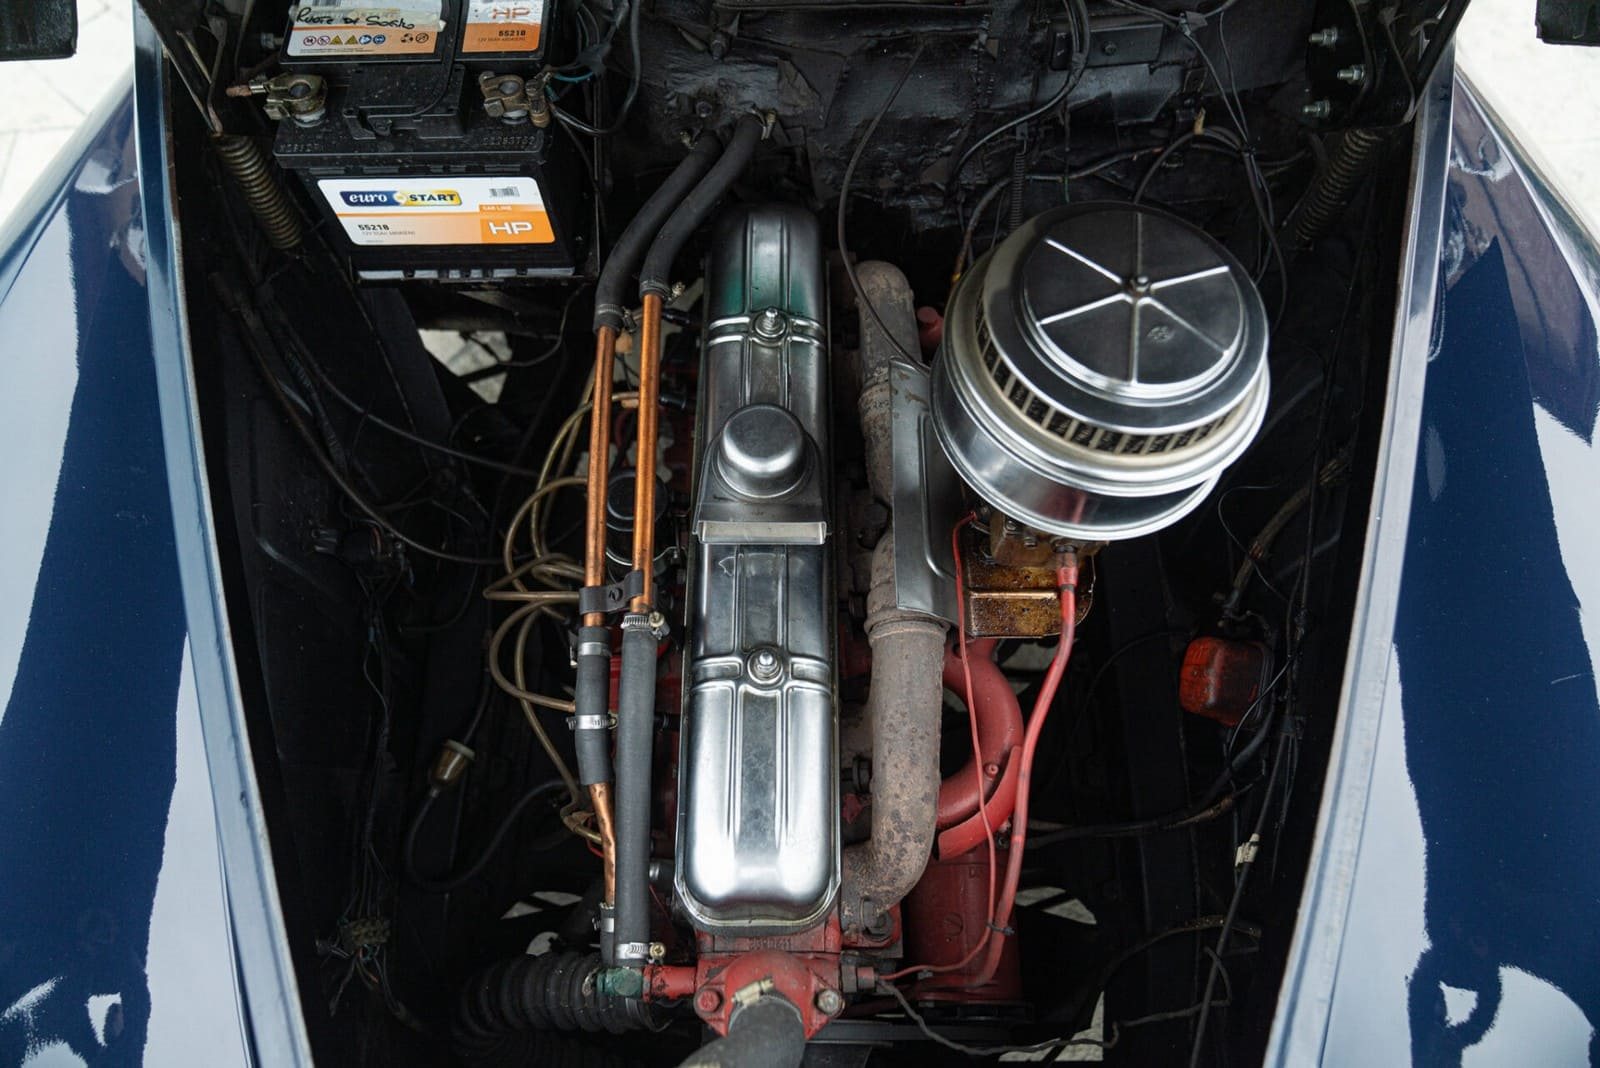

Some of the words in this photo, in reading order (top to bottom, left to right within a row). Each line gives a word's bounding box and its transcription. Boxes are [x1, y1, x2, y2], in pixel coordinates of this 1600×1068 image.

[492, 8, 530, 19] HP
[349, 193, 388, 203] euro
[409, 193, 456, 202] START
[488, 221, 533, 235] HP
